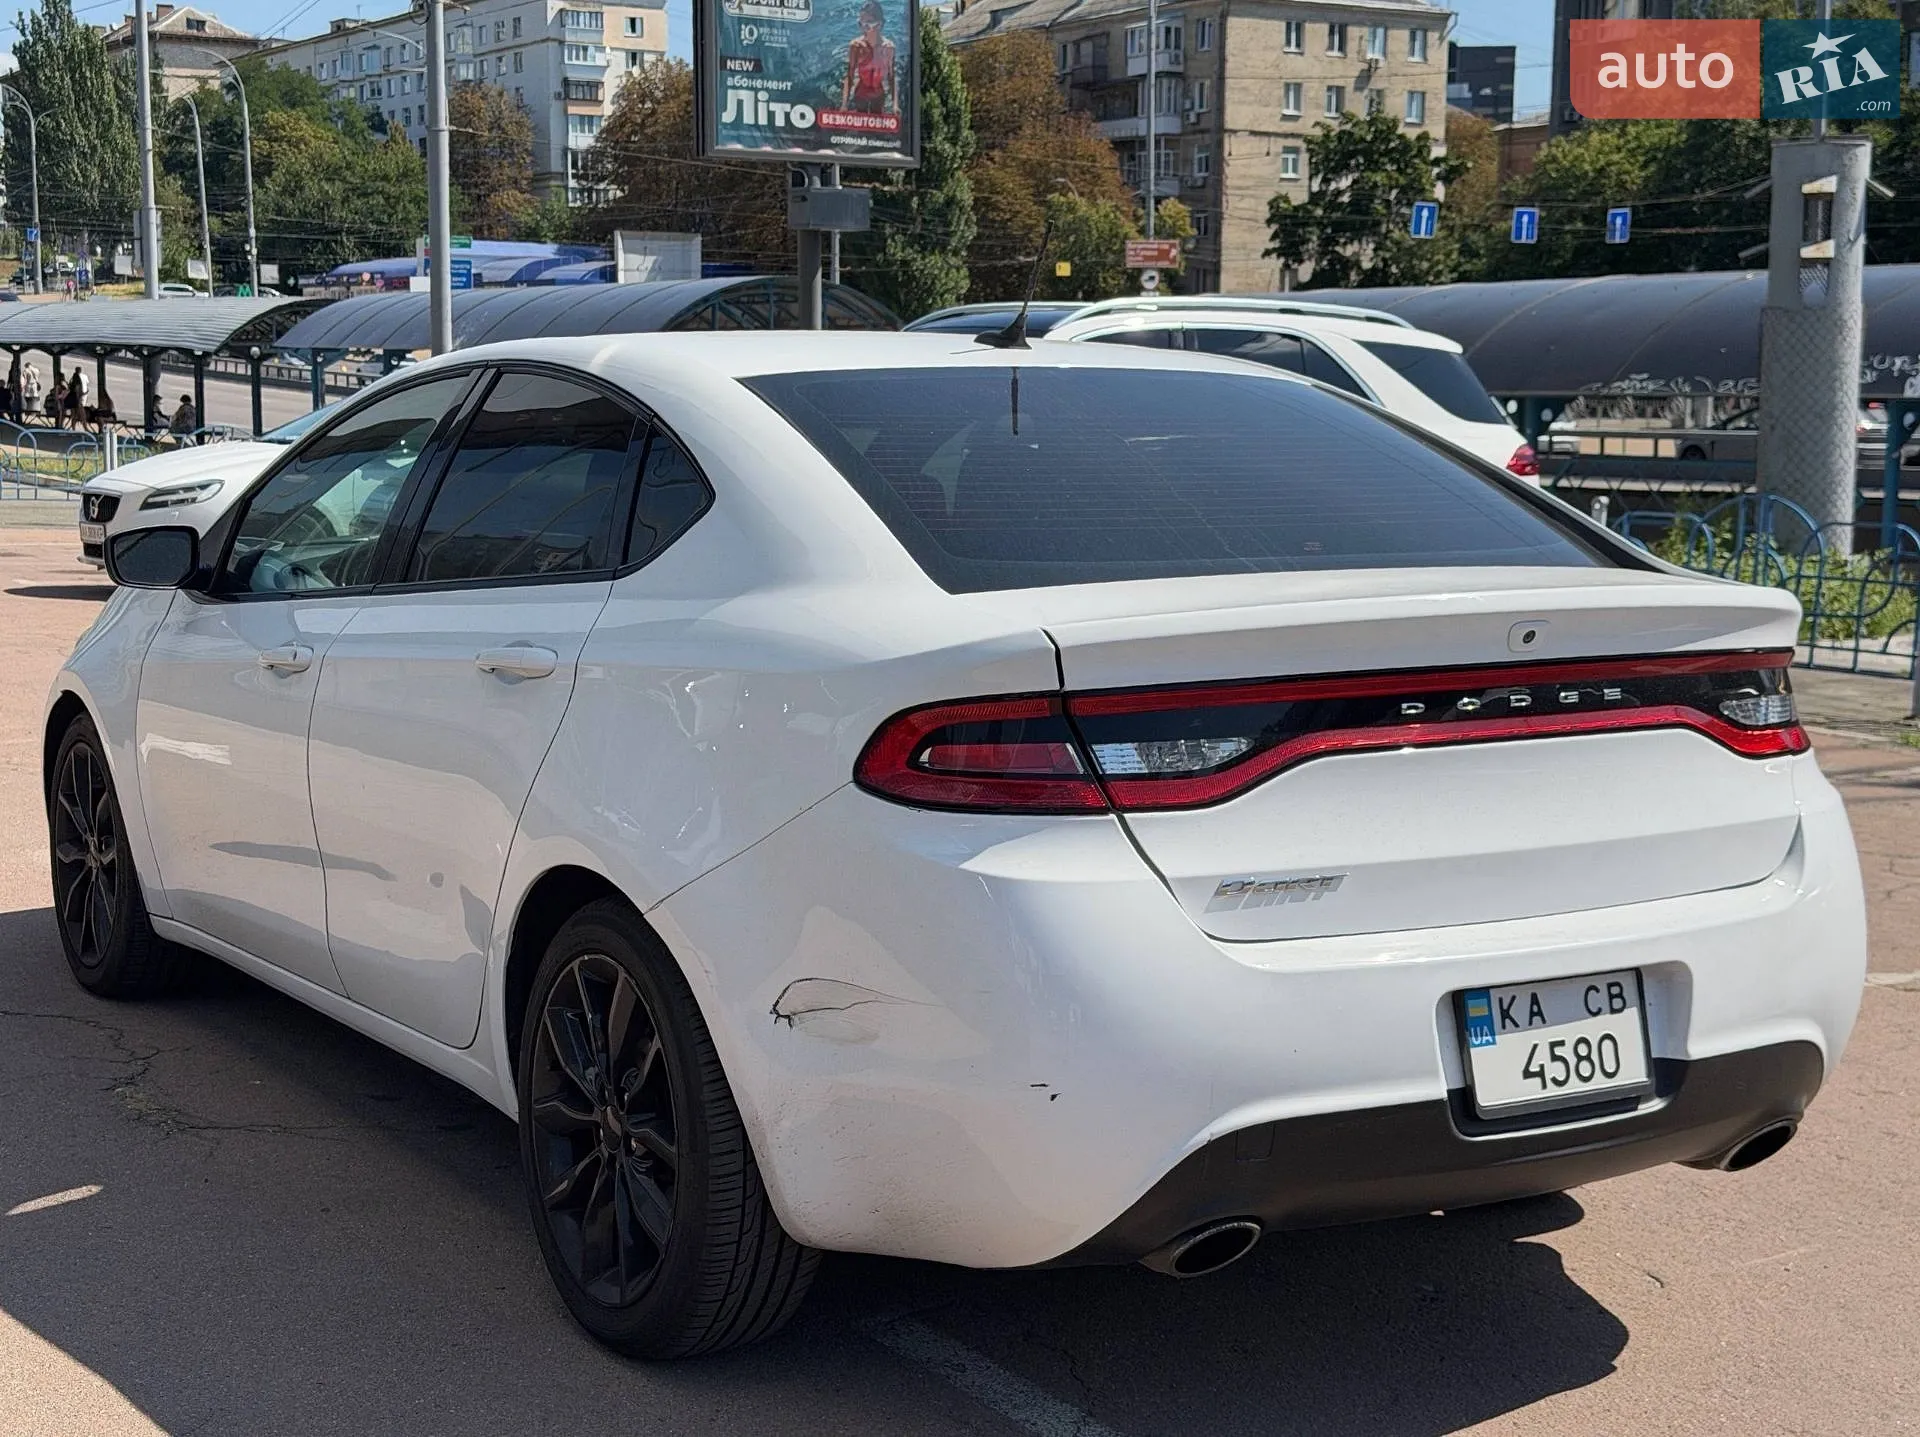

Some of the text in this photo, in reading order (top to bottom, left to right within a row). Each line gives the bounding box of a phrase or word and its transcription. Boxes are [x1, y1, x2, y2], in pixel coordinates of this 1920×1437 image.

[726, 59, 755, 72] NEW
[726, 75, 793, 91] абонемент
[721, 89, 816, 129] Літо
[822, 113, 898, 130] БЕЗКОШТОВНО
[1400, 687, 1622, 715] DODGE
[1470, 1026, 1493, 1046] UA
[1522, 1032, 1621, 1090] 4580
